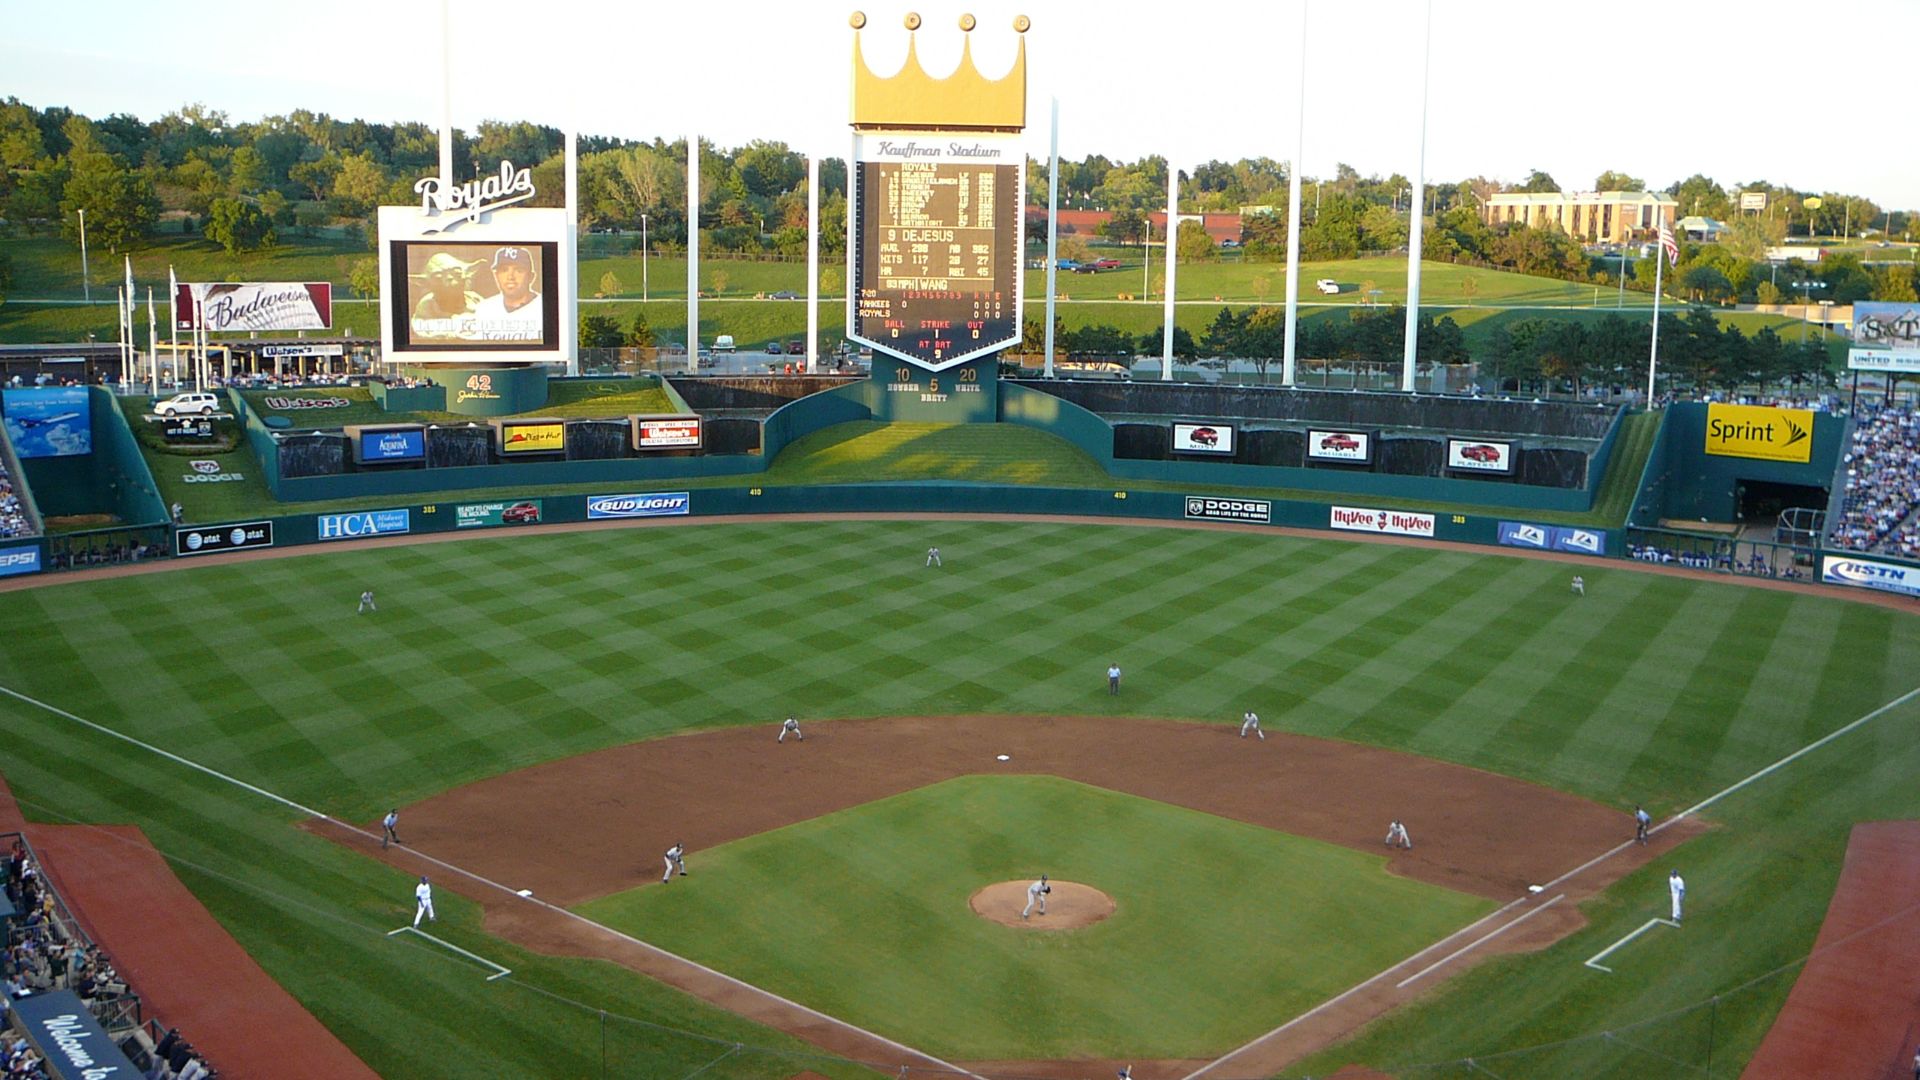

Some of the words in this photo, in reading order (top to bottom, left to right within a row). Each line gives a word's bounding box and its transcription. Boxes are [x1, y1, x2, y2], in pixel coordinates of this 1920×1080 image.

[876, 141, 941, 158] Kauffman
[946, 142, 1001, 158] Stadium
[902, 163, 937, 172] ROYALS
[414, 160, 536, 226] Royals
[888, 230, 896, 242] 9
[902, 230, 954, 242] DEJESUS
[504, 247, 518, 258] KC
[880, 255, 902, 264] HITS
[912, 255, 928, 264] 117
[976, 256, 988, 265] 27
[922, 266, 928, 276] 7
[920, 280, 948, 290] WANG
[208, 290, 310, 327] Budweiser
[891, 329, 898, 338] 0
[935, 329, 939, 338] 1
[972, 330, 979, 339] 0
[266, 346, 312, 356] Watson's
[934, 350, 942, 359] 9
[896, 368, 910, 382] 10
[960, 368, 976, 382] 20
[467, 374, 491, 390] 42
[930, 378, 938, 392] 5
[955, 384, 980, 392] WHITE
[265, 397, 350, 410] Watson's
[1710, 418, 1774, 444] Sprint
[182, 473, 245, 483] DODGE
[600, 500, 635, 510] BUD
[637, 498, 686, 509] LIGHT
[1206, 501, 1268, 512] DODGE
[322, 513, 379, 538] HCA
[1334, 510, 1373, 525] HyVee
[1392, 514, 1431, 530] HyVee
[0, 552, 36, 566] EPSI
[1846, 562, 1906, 580] RSTN
[42, 1014, 95, 1068] Welcome
[81, 1066, 118, 1080] to
